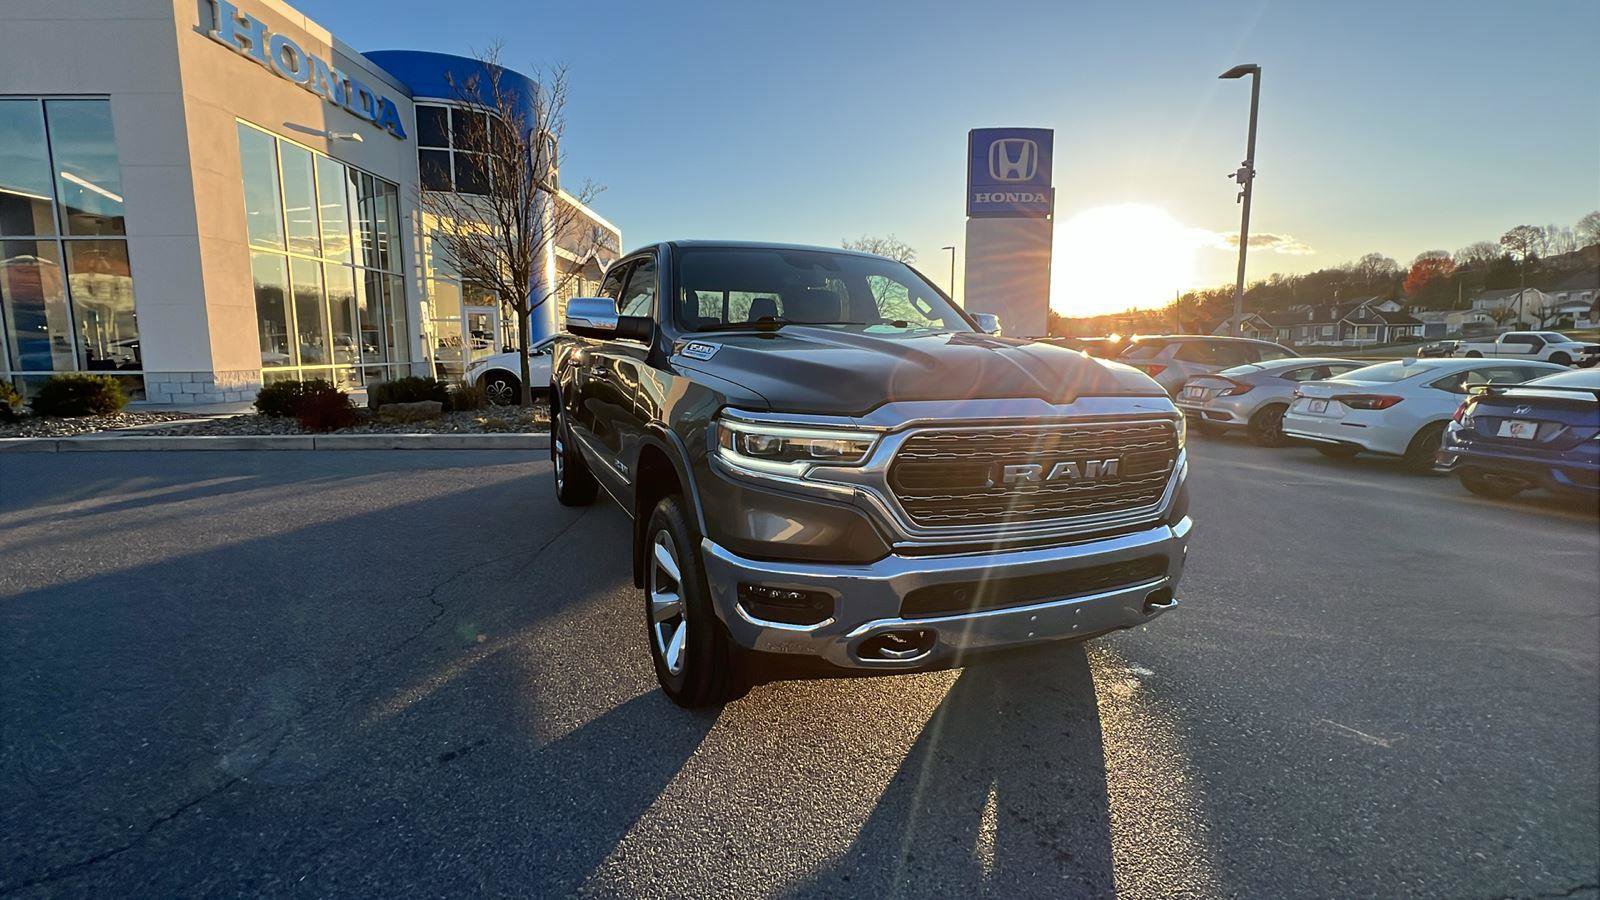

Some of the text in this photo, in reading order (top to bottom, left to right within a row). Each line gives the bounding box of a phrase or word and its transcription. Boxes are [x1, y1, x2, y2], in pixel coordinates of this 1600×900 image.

[209, 0, 407, 139] HONDA
[974, 192, 1048, 203] HONDA
[1003, 458, 1119, 482] RAM
